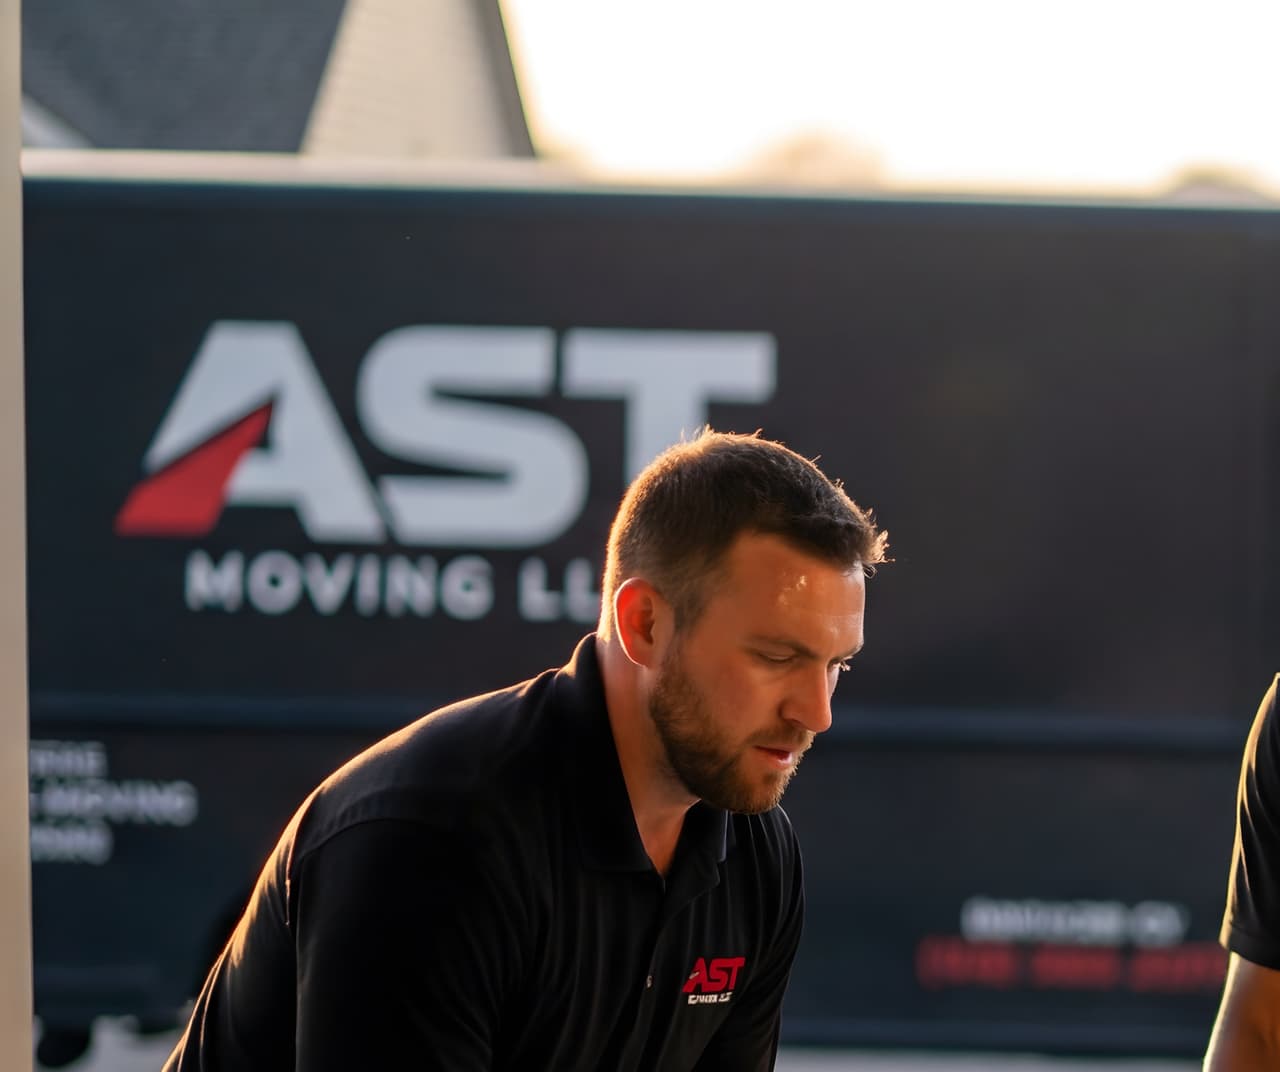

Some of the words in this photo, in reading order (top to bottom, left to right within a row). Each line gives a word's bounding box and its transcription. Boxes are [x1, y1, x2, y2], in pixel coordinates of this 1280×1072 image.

[114, 318, 778, 548] AST
[184, 548, 494, 622] MOVING
[517, 555, 602, 624] LL
[682, 956, 746, 993] AST
